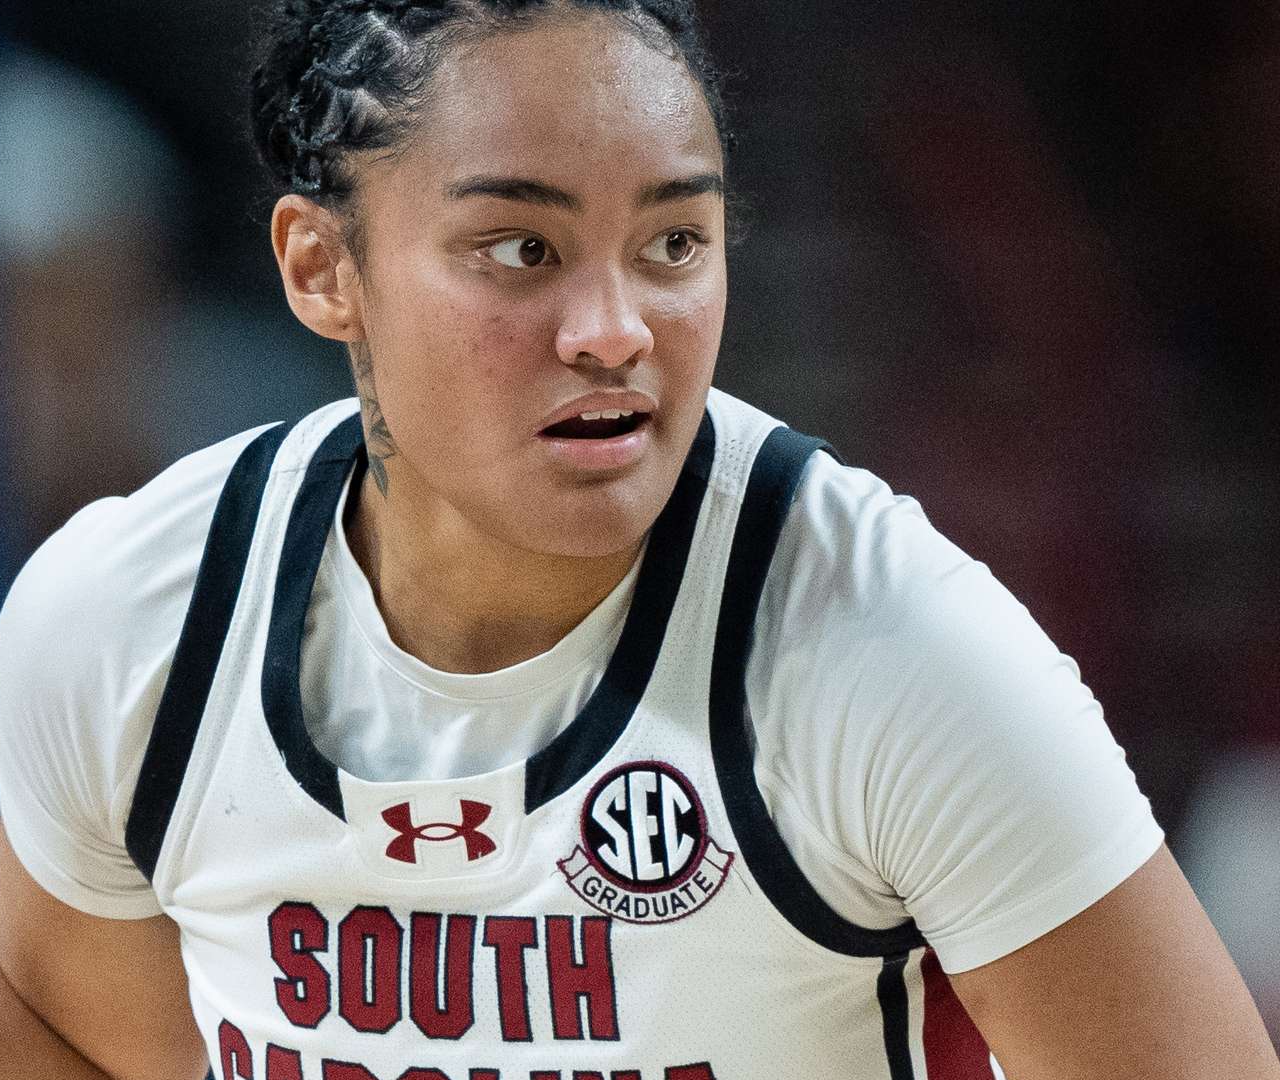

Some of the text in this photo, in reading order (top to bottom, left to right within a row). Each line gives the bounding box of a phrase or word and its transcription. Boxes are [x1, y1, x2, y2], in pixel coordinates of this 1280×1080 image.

[591, 770, 696, 881] SEC
[582, 869, 715, 919] GRADUATE
[267, 900, 621, 1043] SOUTH
